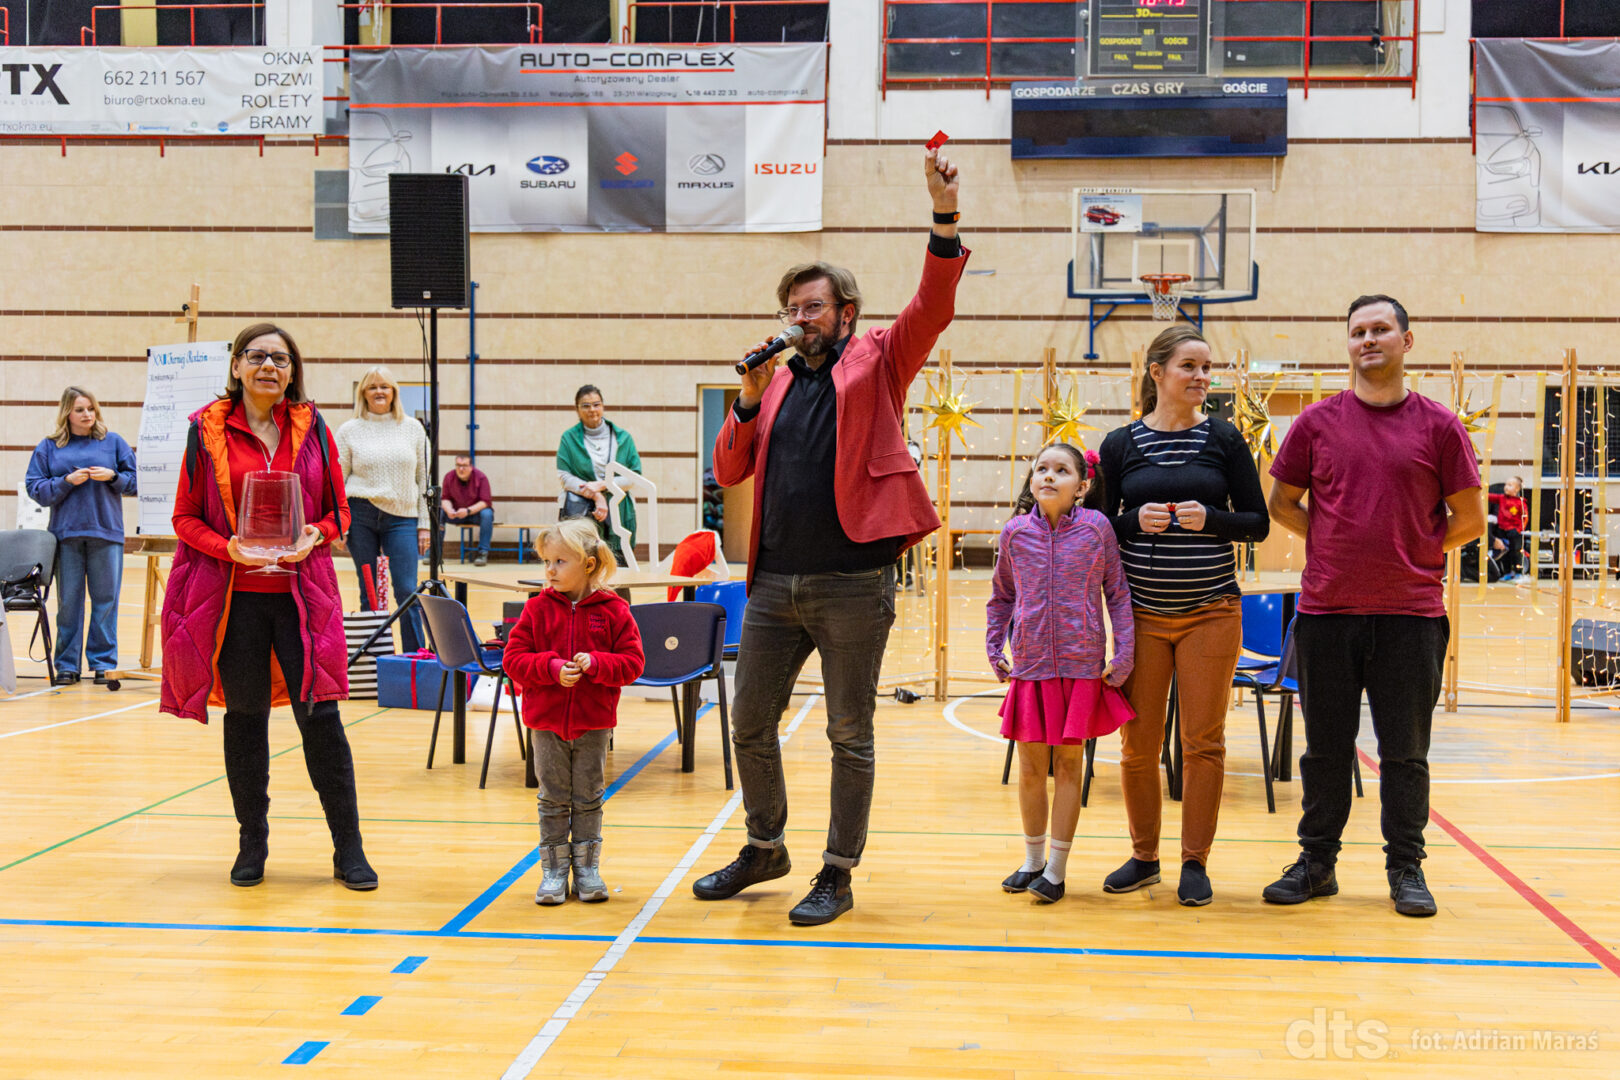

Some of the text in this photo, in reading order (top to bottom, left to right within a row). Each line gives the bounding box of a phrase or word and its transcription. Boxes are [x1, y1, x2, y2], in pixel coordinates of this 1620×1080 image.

[263, 52, 313, 65] OKNA
[520, 52, 735, 67] AUTO-COMPLEX
[104, 70, 206, 85] 662 211 567
[255, 73, 312, 86] DRZWI
[574, 74, 680, 84] Autoryzowany Dealer
[0, 64, 70, 105] TX
[1112, 82, 1185, 95] CZAS GRY
[1222, 80, 1268, 93] GOŚCIE
[1015, 86, 1096, 98] GOSPODARZE
[104, 94, 205, 106] biuro@rtxokna.eu
[241, 94, 312, 108] ROLETY
[250, 115, 312, 129] BRAMY
[754, 163, 817, 175] ISUZU
[520, 180, 576, 189] SUBARU
[678, 181, 734, 189] MAXUS
